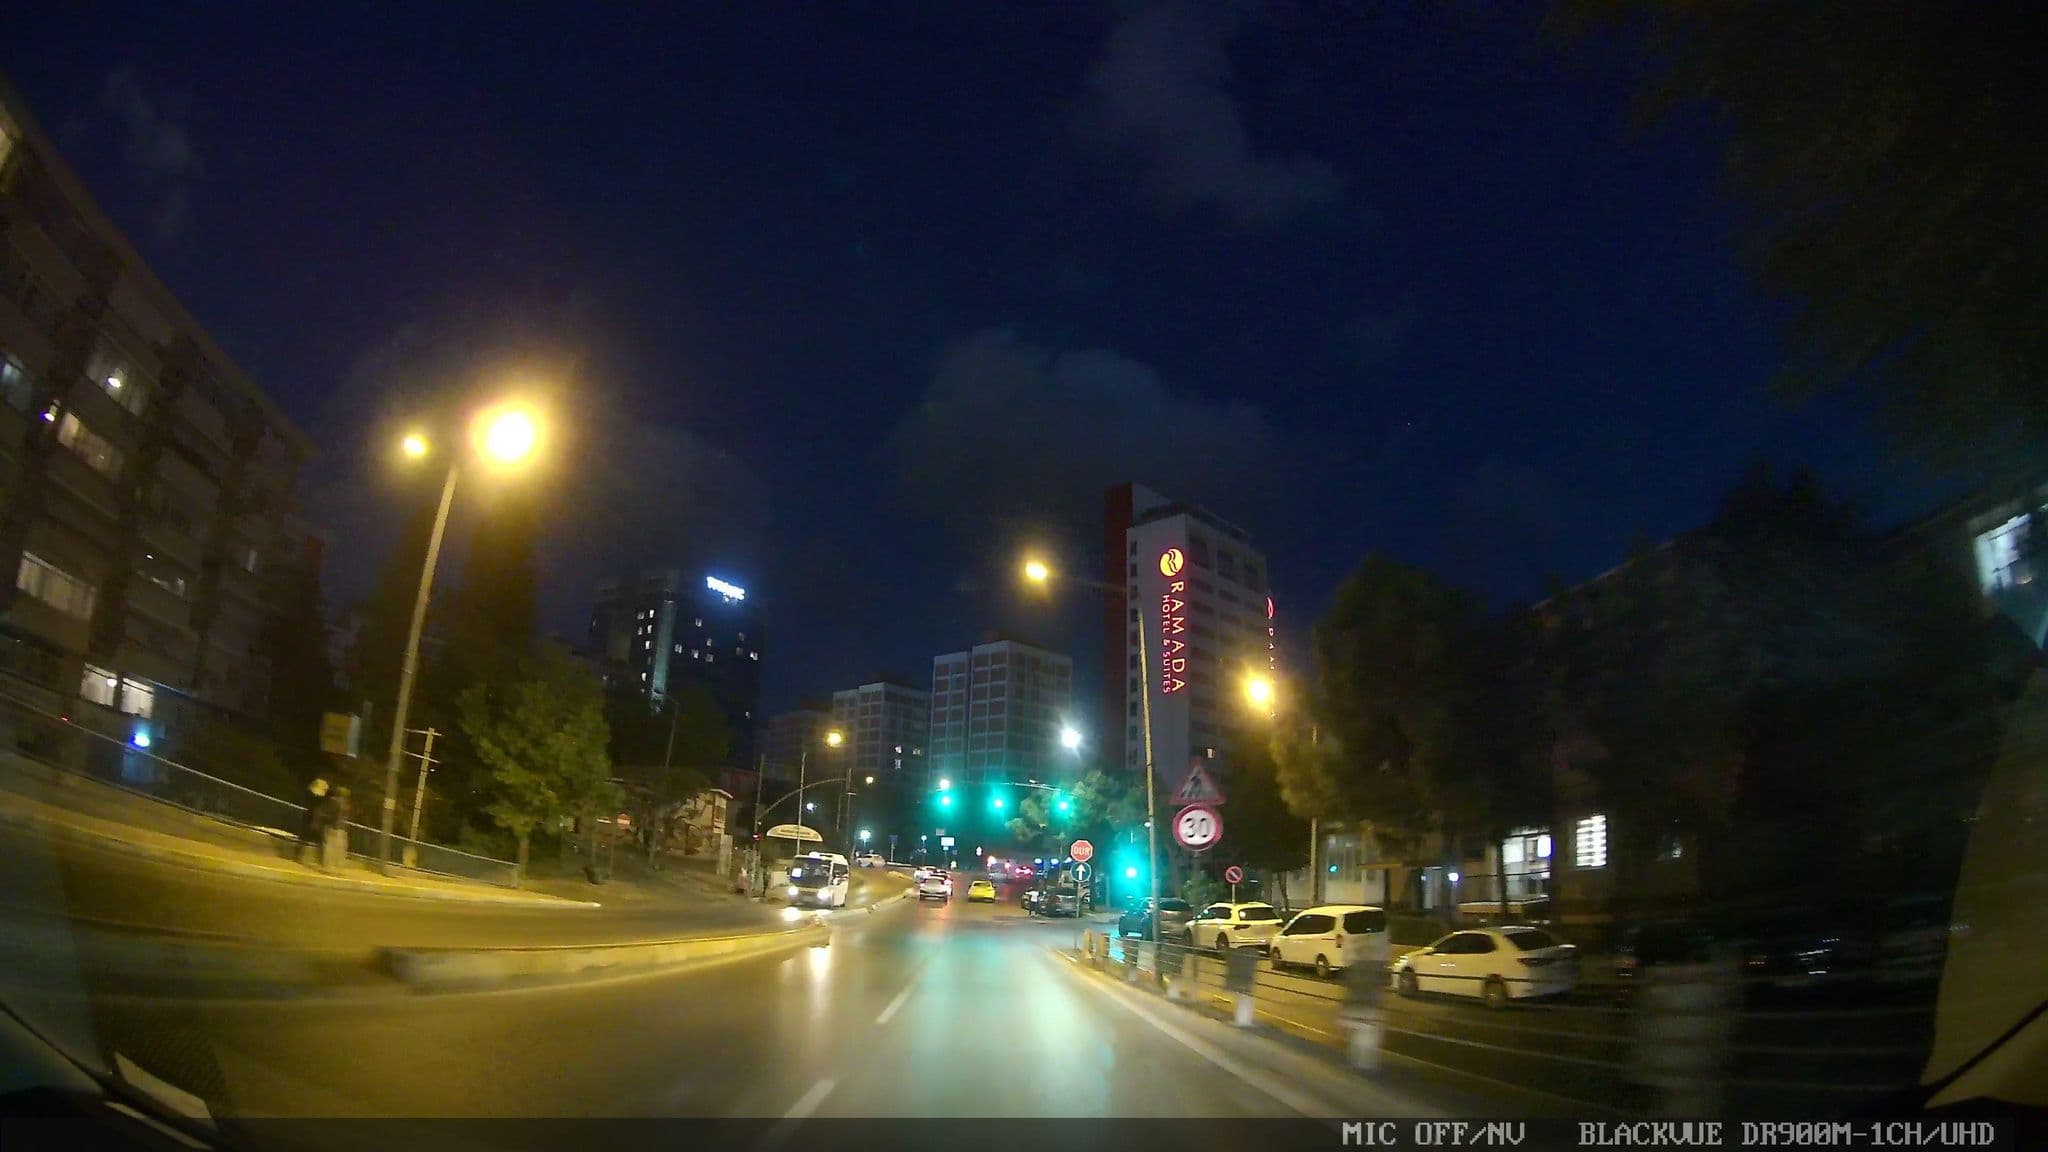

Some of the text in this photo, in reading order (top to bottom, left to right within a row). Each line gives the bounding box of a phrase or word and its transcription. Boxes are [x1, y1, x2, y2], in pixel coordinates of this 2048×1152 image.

[1162, 595, 1170, 633] HOTEL
[1171, 581, 1185, 691] RAMADA
[1162, 652, 1171, 693] SUITES
[1184, 817, 1211, 838] 30
[1072, 846, 1090, 856] DUR
